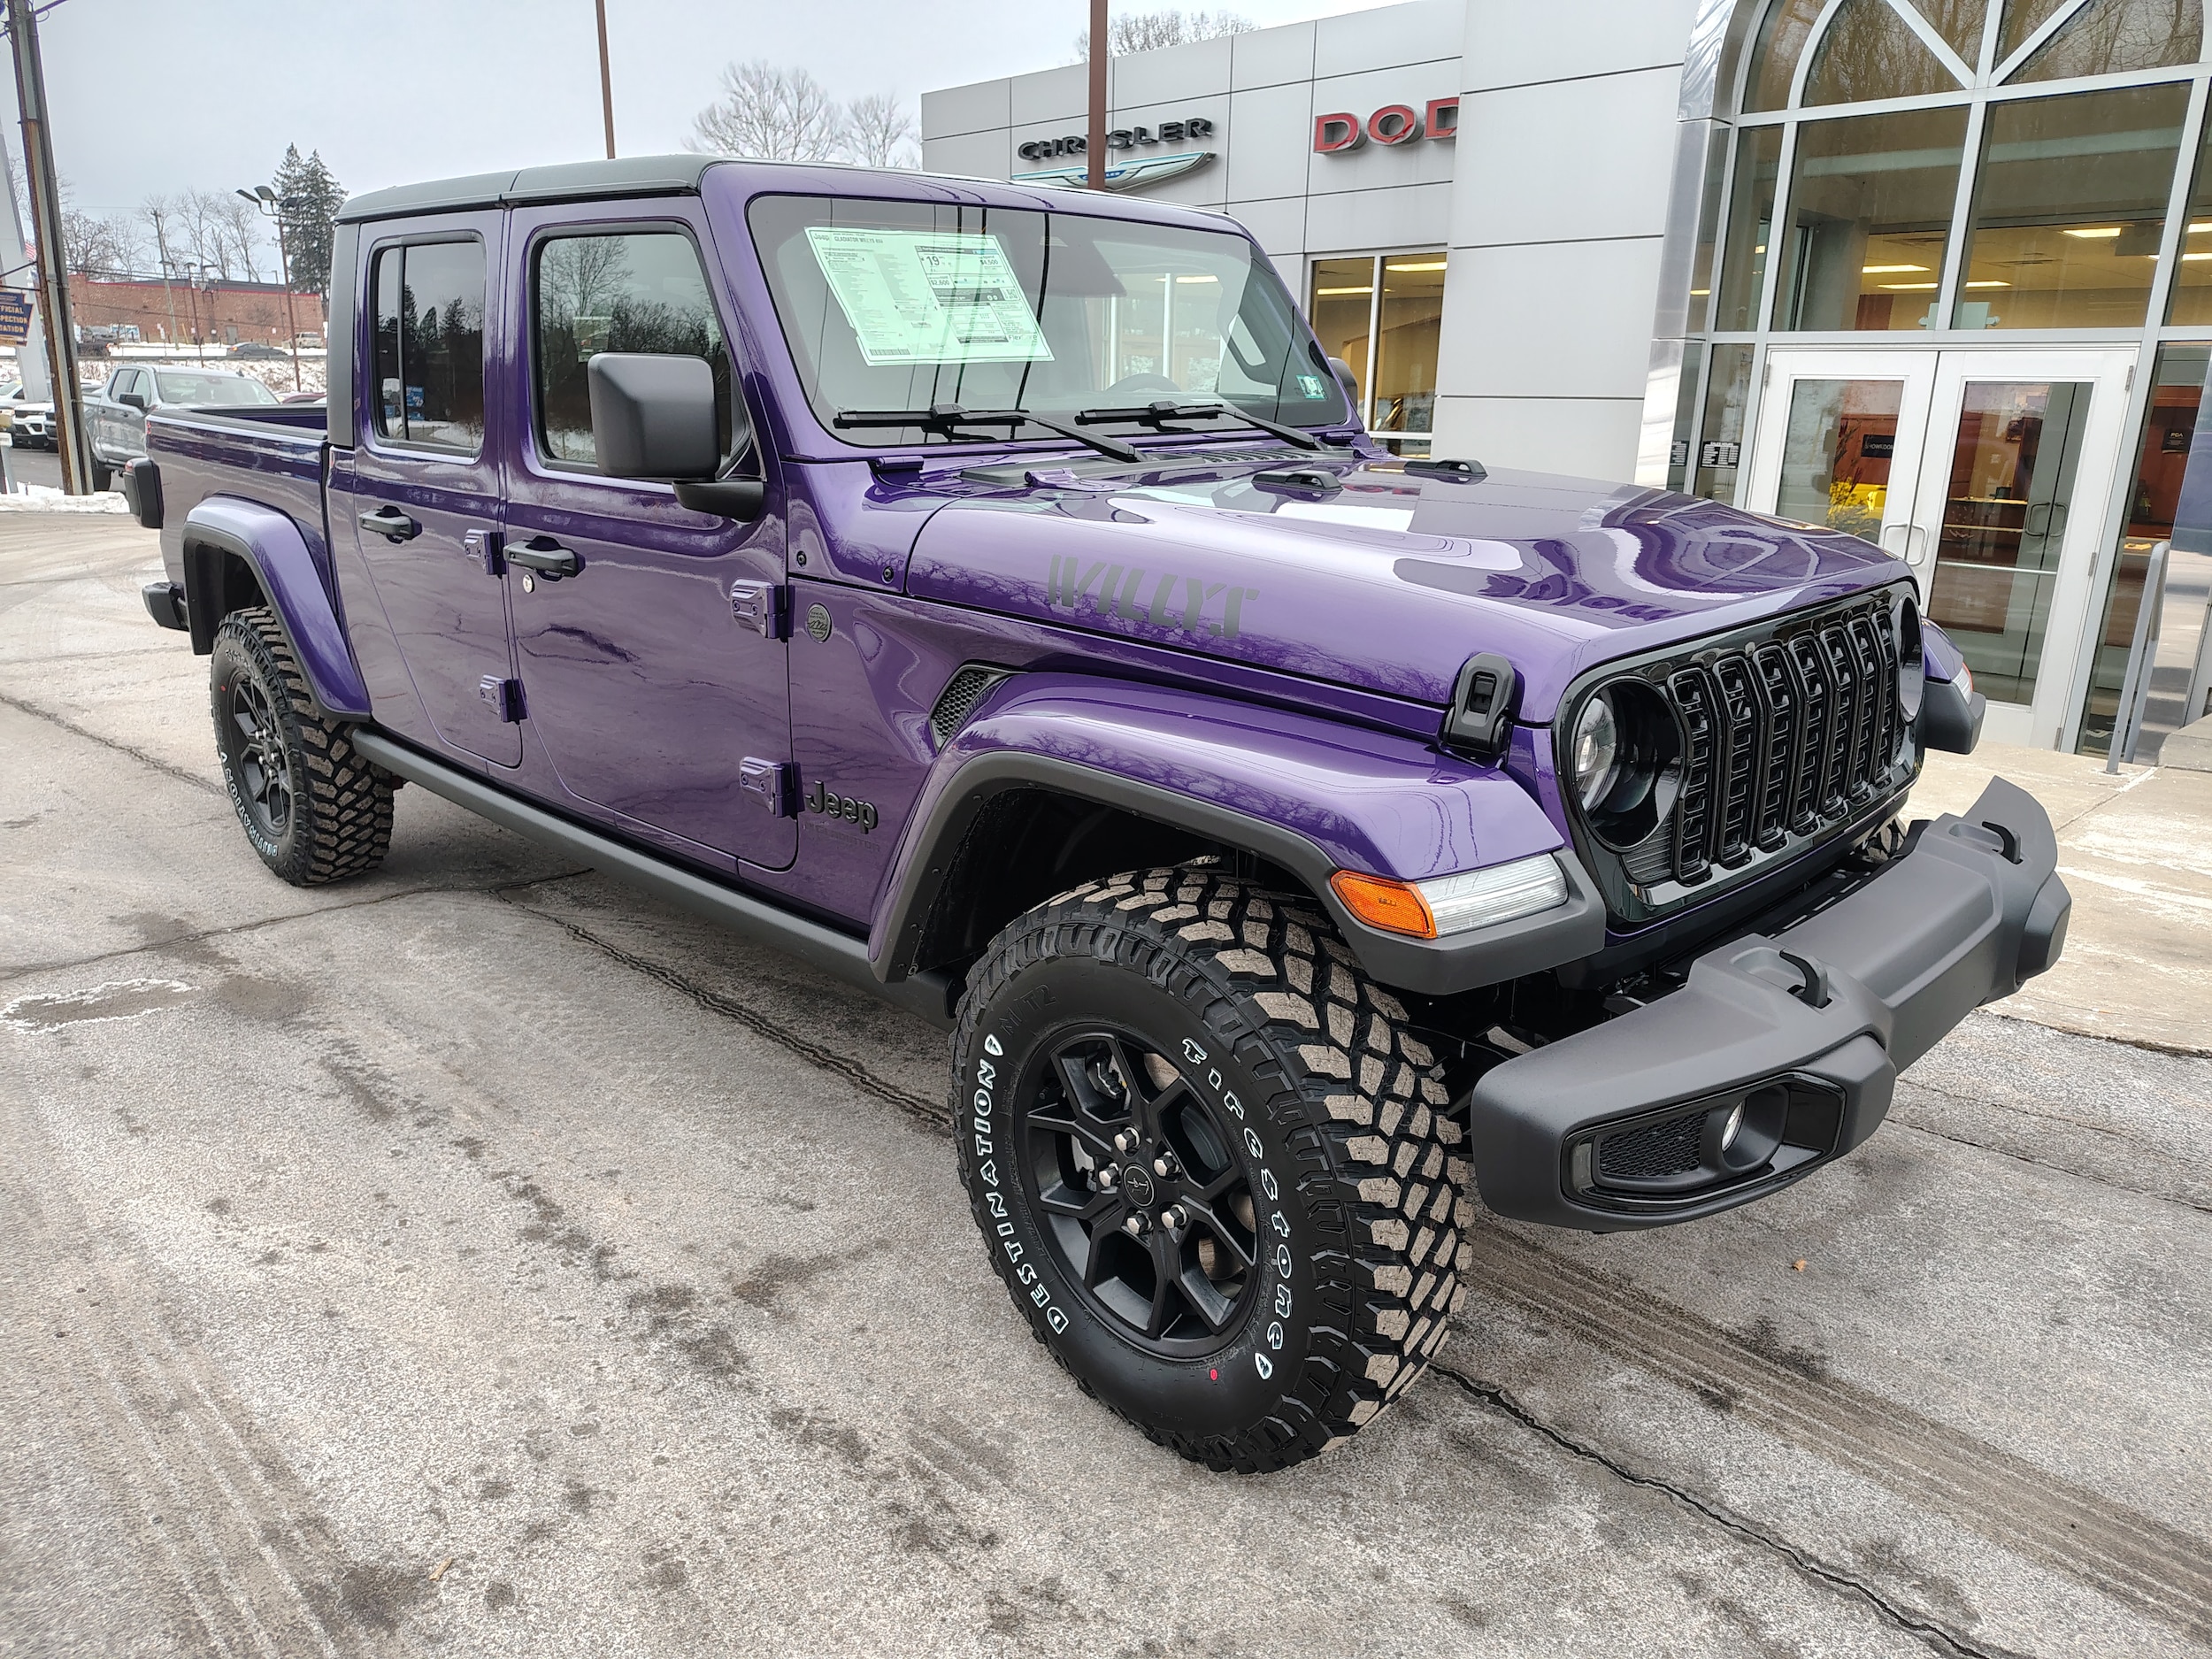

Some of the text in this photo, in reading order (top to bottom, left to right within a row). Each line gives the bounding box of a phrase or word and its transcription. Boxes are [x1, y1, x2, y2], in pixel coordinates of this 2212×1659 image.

[1018, 117, 1212, 161] CHRSLER
[926, 256, 941, 266] 19
[0, 315, 27, 324] PECTION
[1048, 554, 1260, 640] WILLYS
[805, 780, 879, 834] Jeep
[973, 1058, 1070, 1335] DESTINATION
[1182, 1036, 1294, 1350] Firestone
